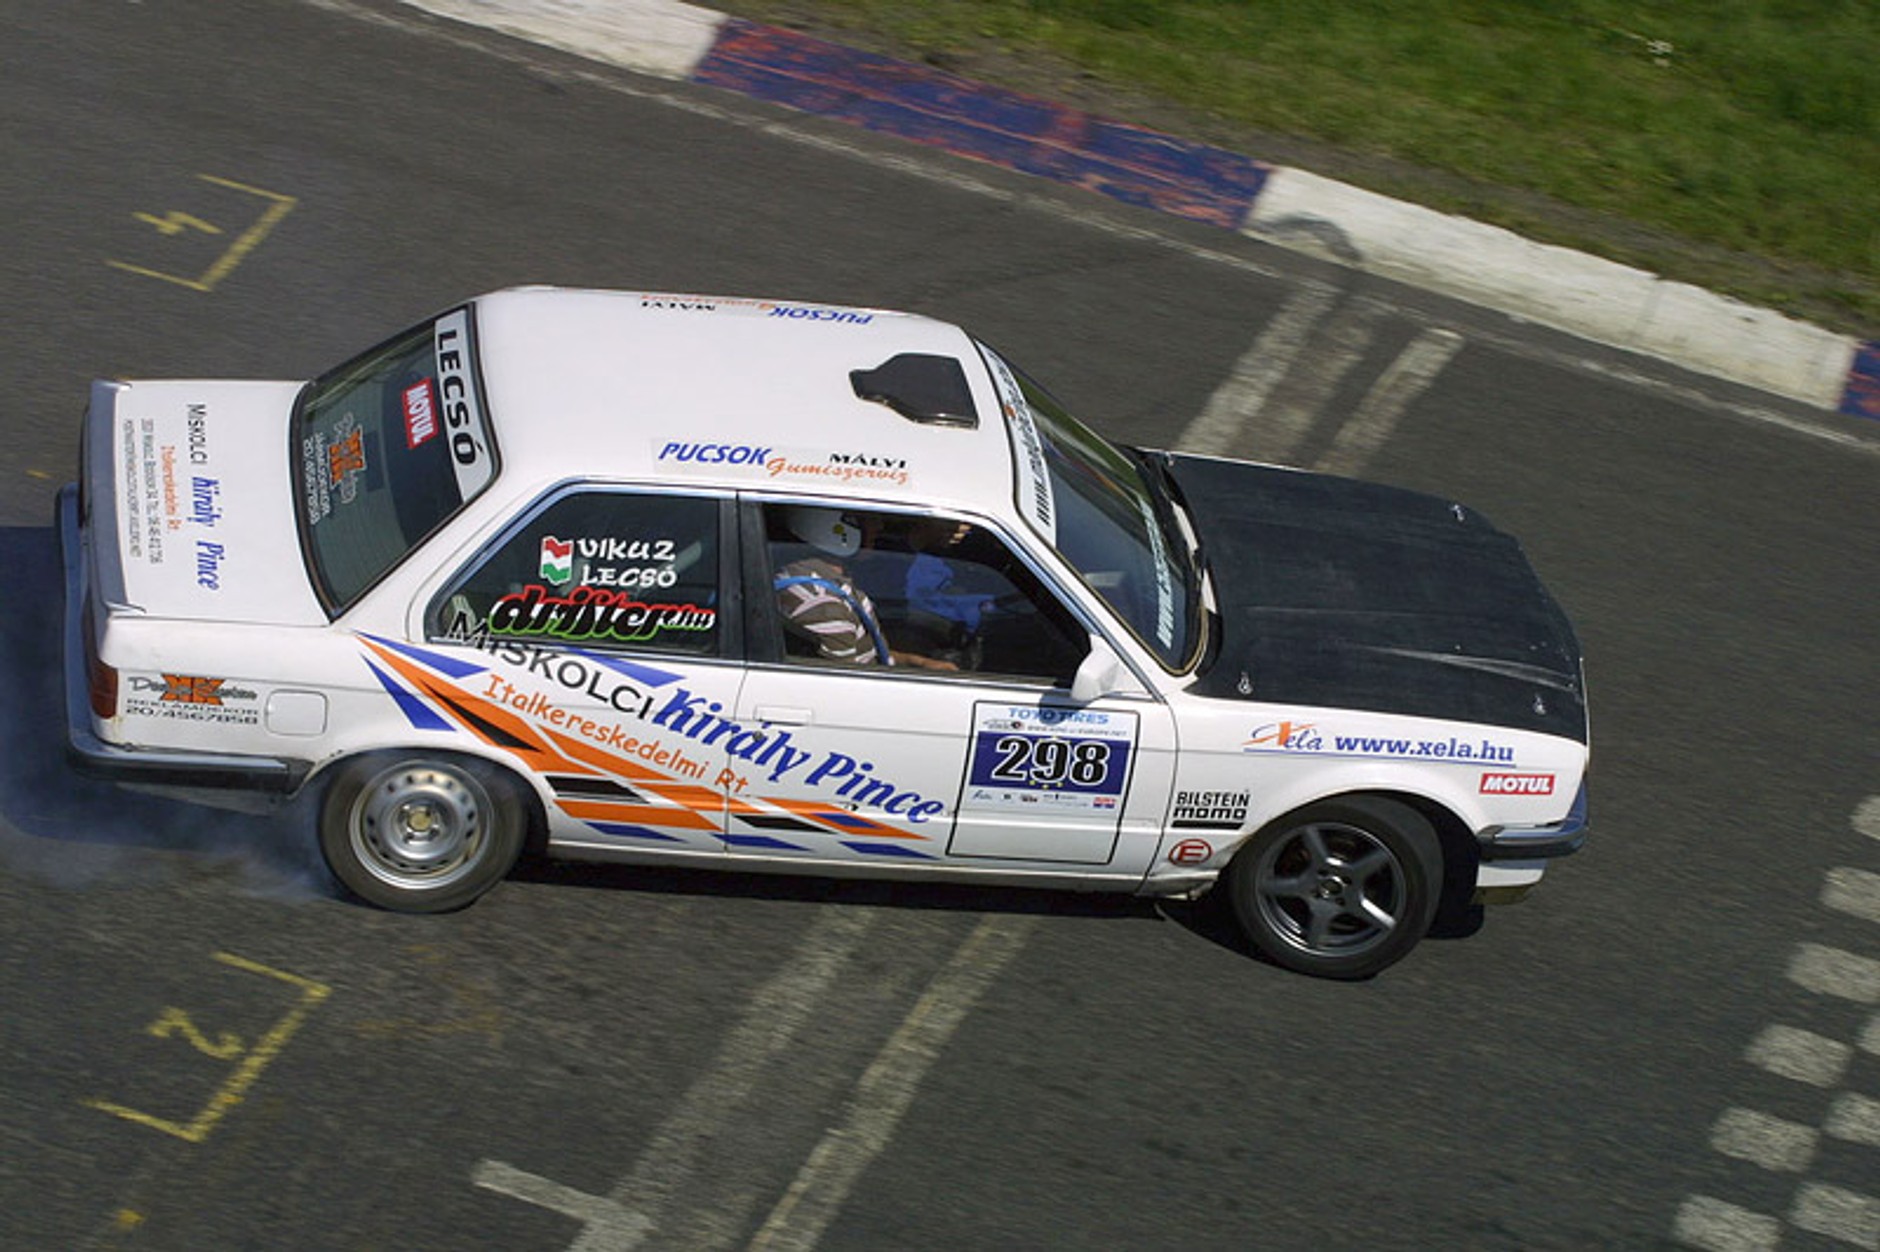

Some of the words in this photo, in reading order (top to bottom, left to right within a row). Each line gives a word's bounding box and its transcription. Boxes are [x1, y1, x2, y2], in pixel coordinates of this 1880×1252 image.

[768, 306, 874, 326] PUCSOK
[437, 328, 484, 466] LECSÓ
[407, 382, 434, 445] MOTUL
[657, 442, 773, 467] PUCSOK
[829, 452, 908, 469] MÁLYI
[766, 457, 910, 486] Gumiszerviz
[196, 540, 226, 591] Pince
[580, 564, 677, 587] LECSÓ
[1007, 707, 1059, 722] TOYO
[481, 673, 712, 780] Italkereskedelmi
[713, 767, 750, 793] Rt
[652, 688, 811, 783] Király
[804, 751, 944, 824] Pince
[991, 735, 1111, 786] 298
[1334, 734, 1515, 762] www.xela.hu
[1483, 775, 1553, 793] MOTUL
[1177, 791, 1250, 807] BILSTEIN
[1172, 807, 1247, 819] momo
